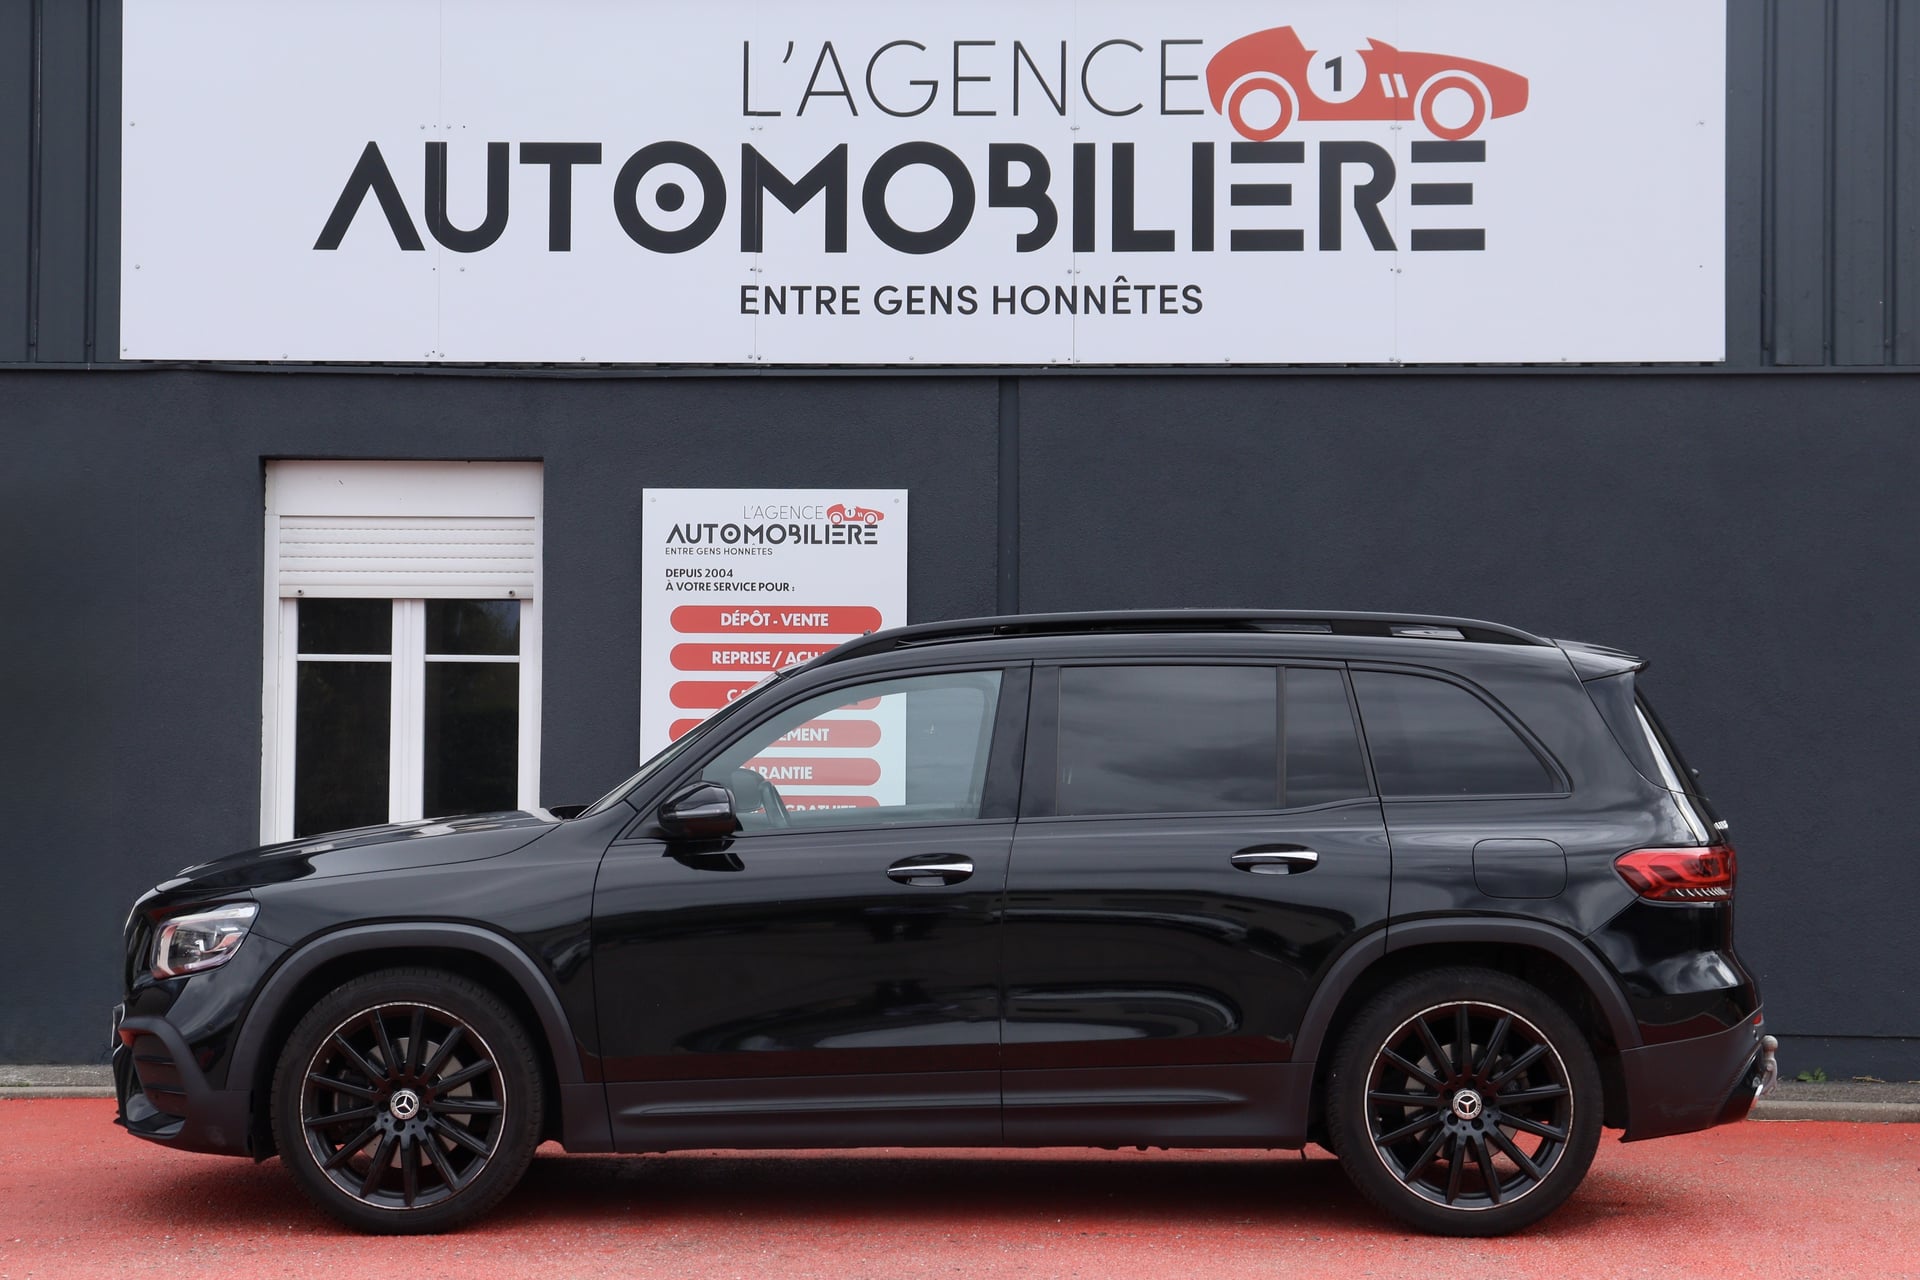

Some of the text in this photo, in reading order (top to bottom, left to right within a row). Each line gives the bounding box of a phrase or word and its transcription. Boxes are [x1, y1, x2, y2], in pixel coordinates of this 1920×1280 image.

[743, 39, 1205, 117] L'AGENCE
[1325, 56, 1342, 92] 1
[740, 274, 1204, 315] ENTRE GENS HONNÊTES
[743, 505, 824, 520] L'AGENCE
[665, 543, 774, 556] ENTRE GENS HONNÊTES
[665, 568, 734, 578] DEPUIS 2004
[665, 579, 674, 592] À
[676, 582, 712, 592] VOTRE
[713, 582, 757, 592] SERVICE
[758, 582, 790, 592] POUR
[720, 609, 771, 627] DÉPÔT
[780, 613, 829, 627] VENTE
[712, 651, 771, 665] REPRISE
[785, 651, 827, 665] ACH
